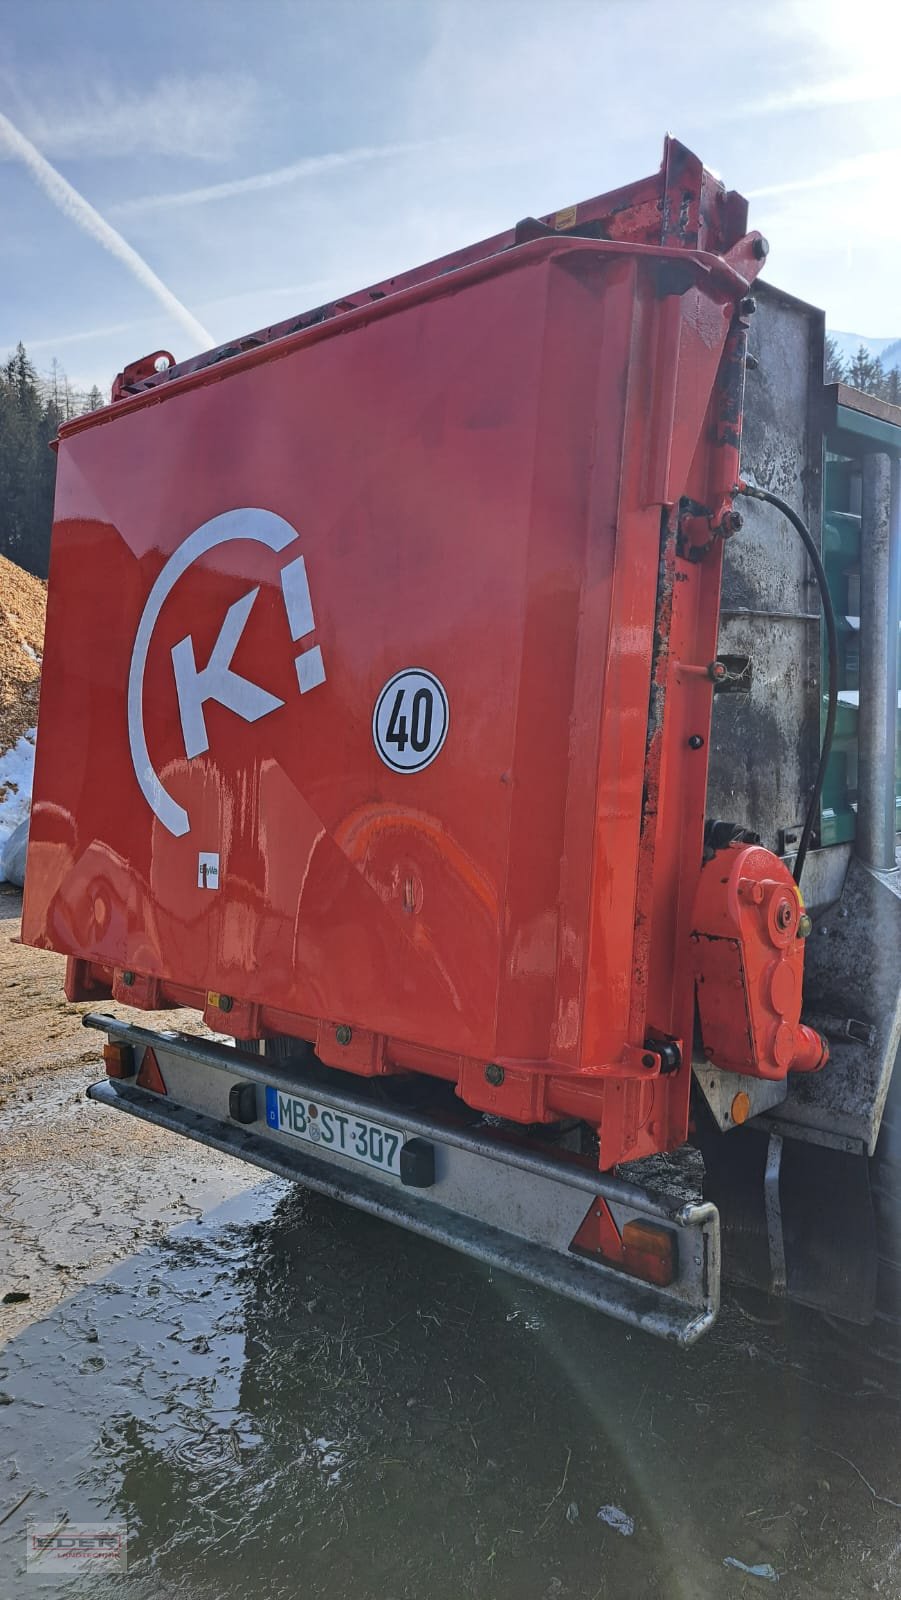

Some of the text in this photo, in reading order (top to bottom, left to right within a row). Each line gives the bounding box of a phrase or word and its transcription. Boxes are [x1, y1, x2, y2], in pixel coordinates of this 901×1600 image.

[385, 687, 433, 753] 40
[199, 864, 218, 876] ByWa
[278, 1095, 399, 1168] MB ST 307
